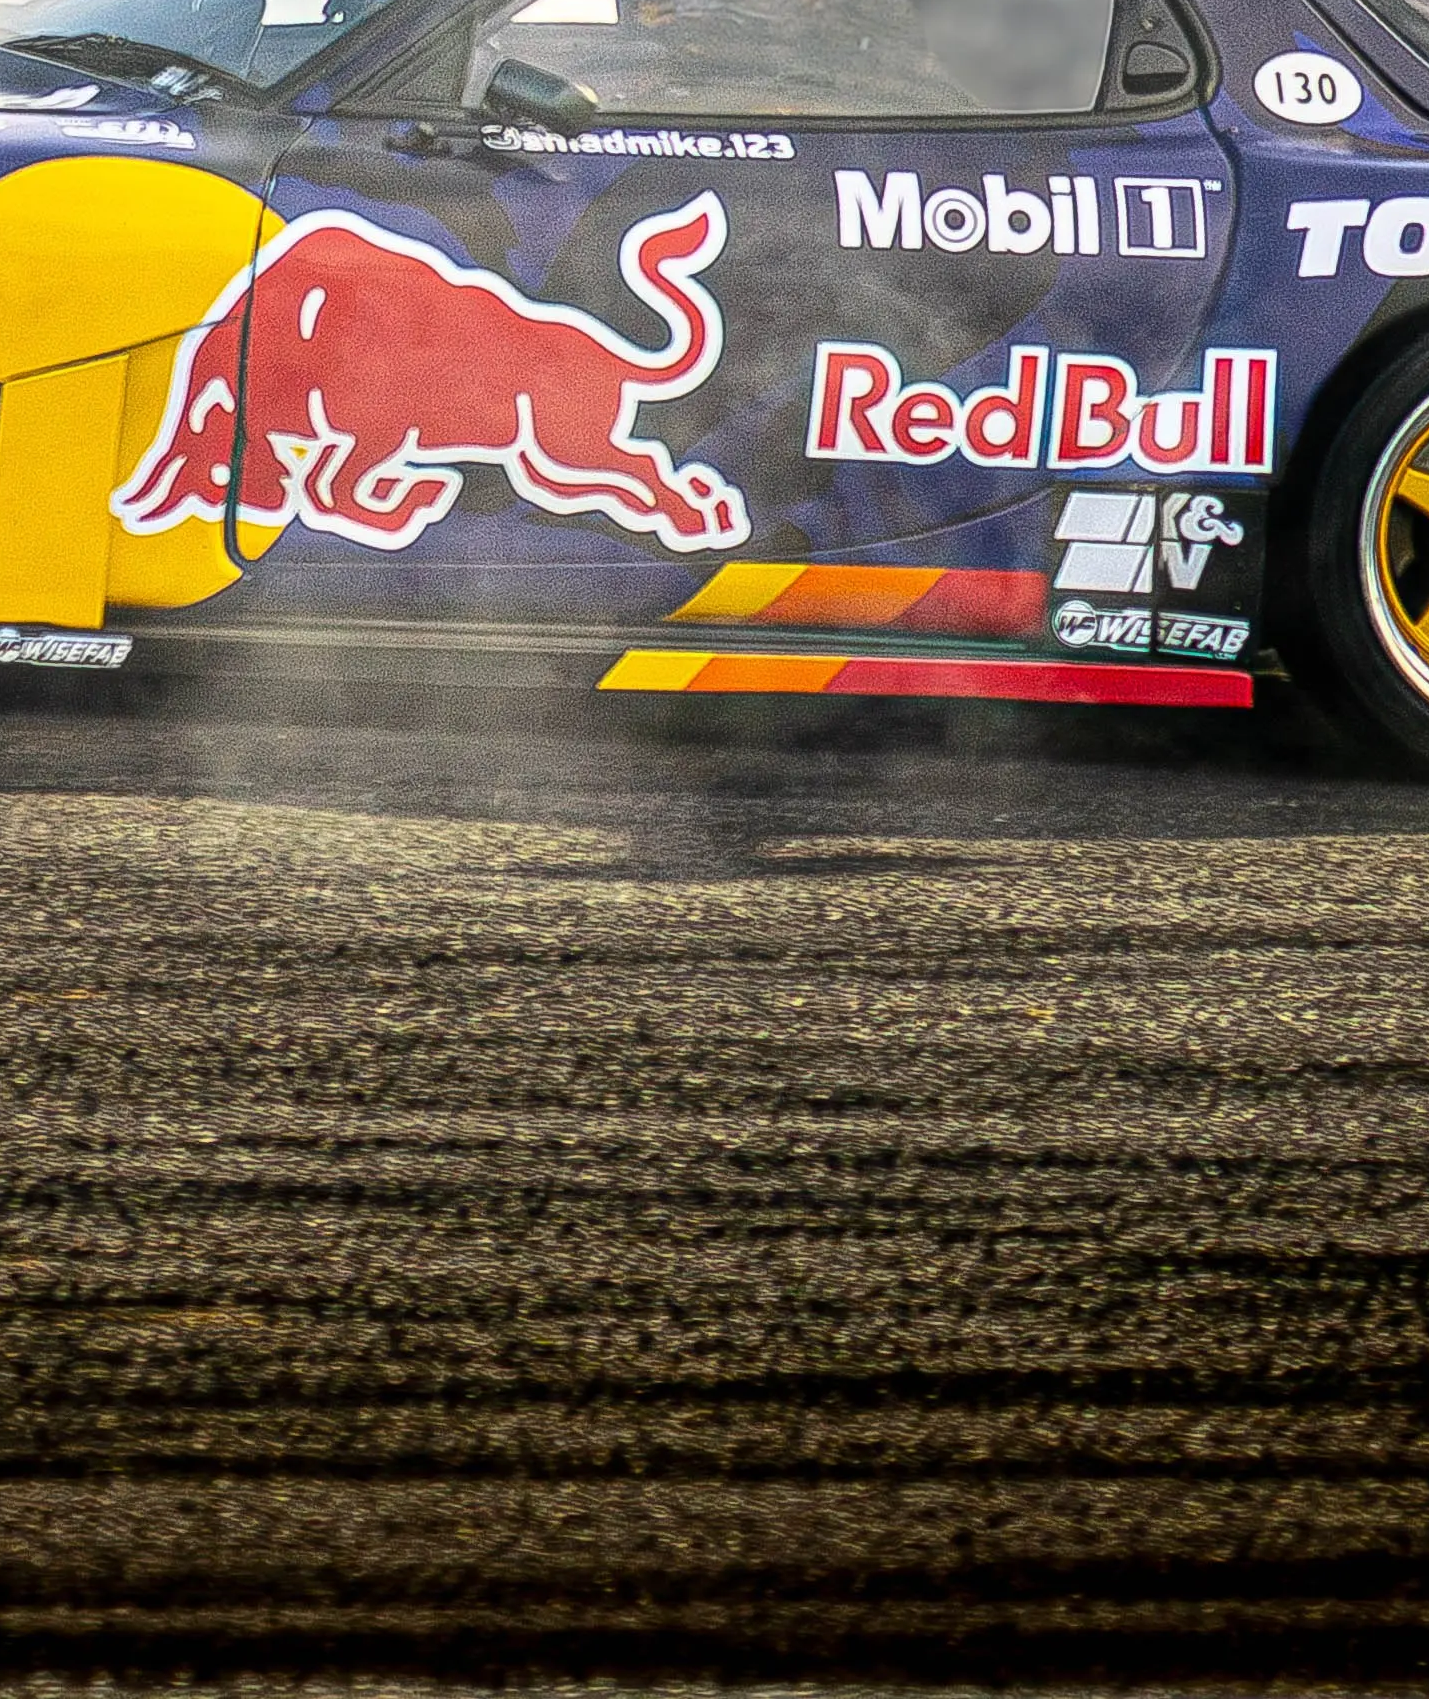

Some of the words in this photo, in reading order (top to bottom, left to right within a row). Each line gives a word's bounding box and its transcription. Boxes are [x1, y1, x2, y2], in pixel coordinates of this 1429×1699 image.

[1274, 70, 1338, 105] 130
[834, 170, 1100, 256] Mobil
[816, 349, 1039, 461] Red
[1054, 354, 1269, 468] Bull
[21, 640, 132, 665] WISEFAB
[1098, 616, 1250, 653] WISEFAB
